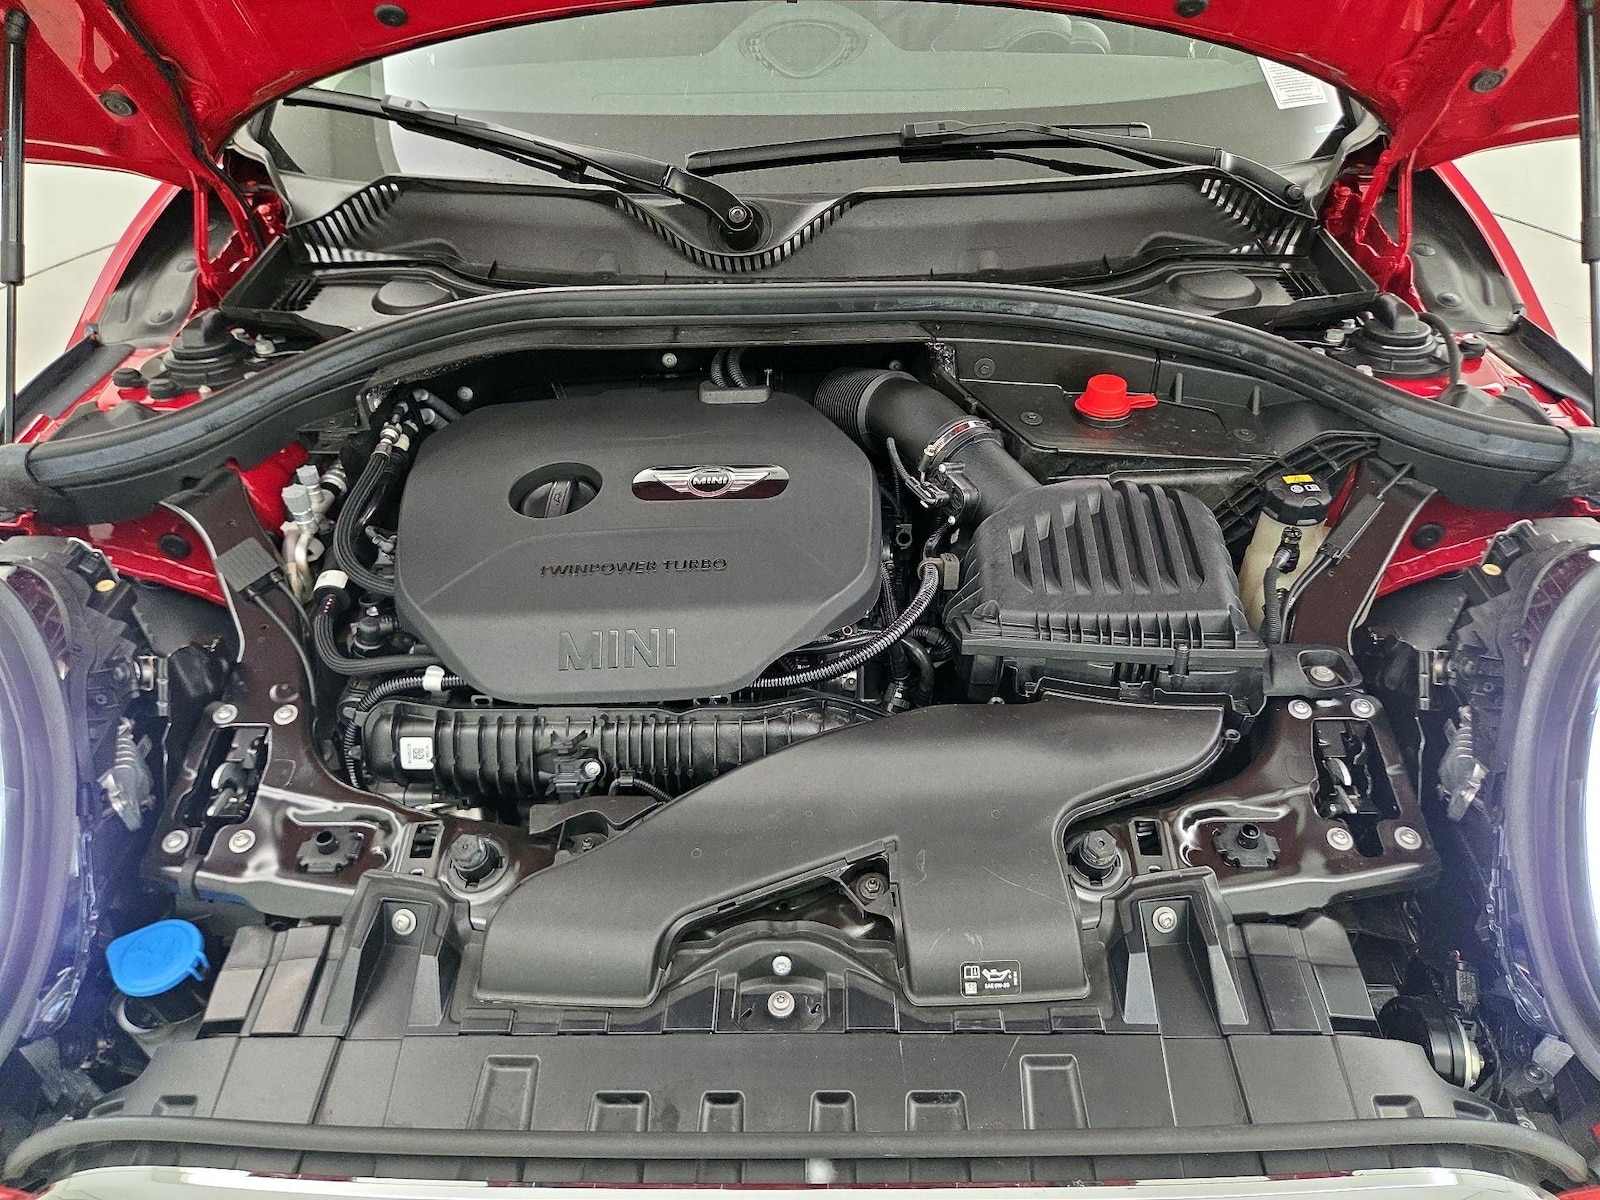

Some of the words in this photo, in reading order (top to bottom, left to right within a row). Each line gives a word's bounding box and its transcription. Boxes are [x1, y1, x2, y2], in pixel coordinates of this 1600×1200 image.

[692, 476, 728, 485] MINI
[540, 561, 658, 577] TWINPOWER
[663, 557, 728, 573] TURBO
[558, 627, 677, 671] MINI
